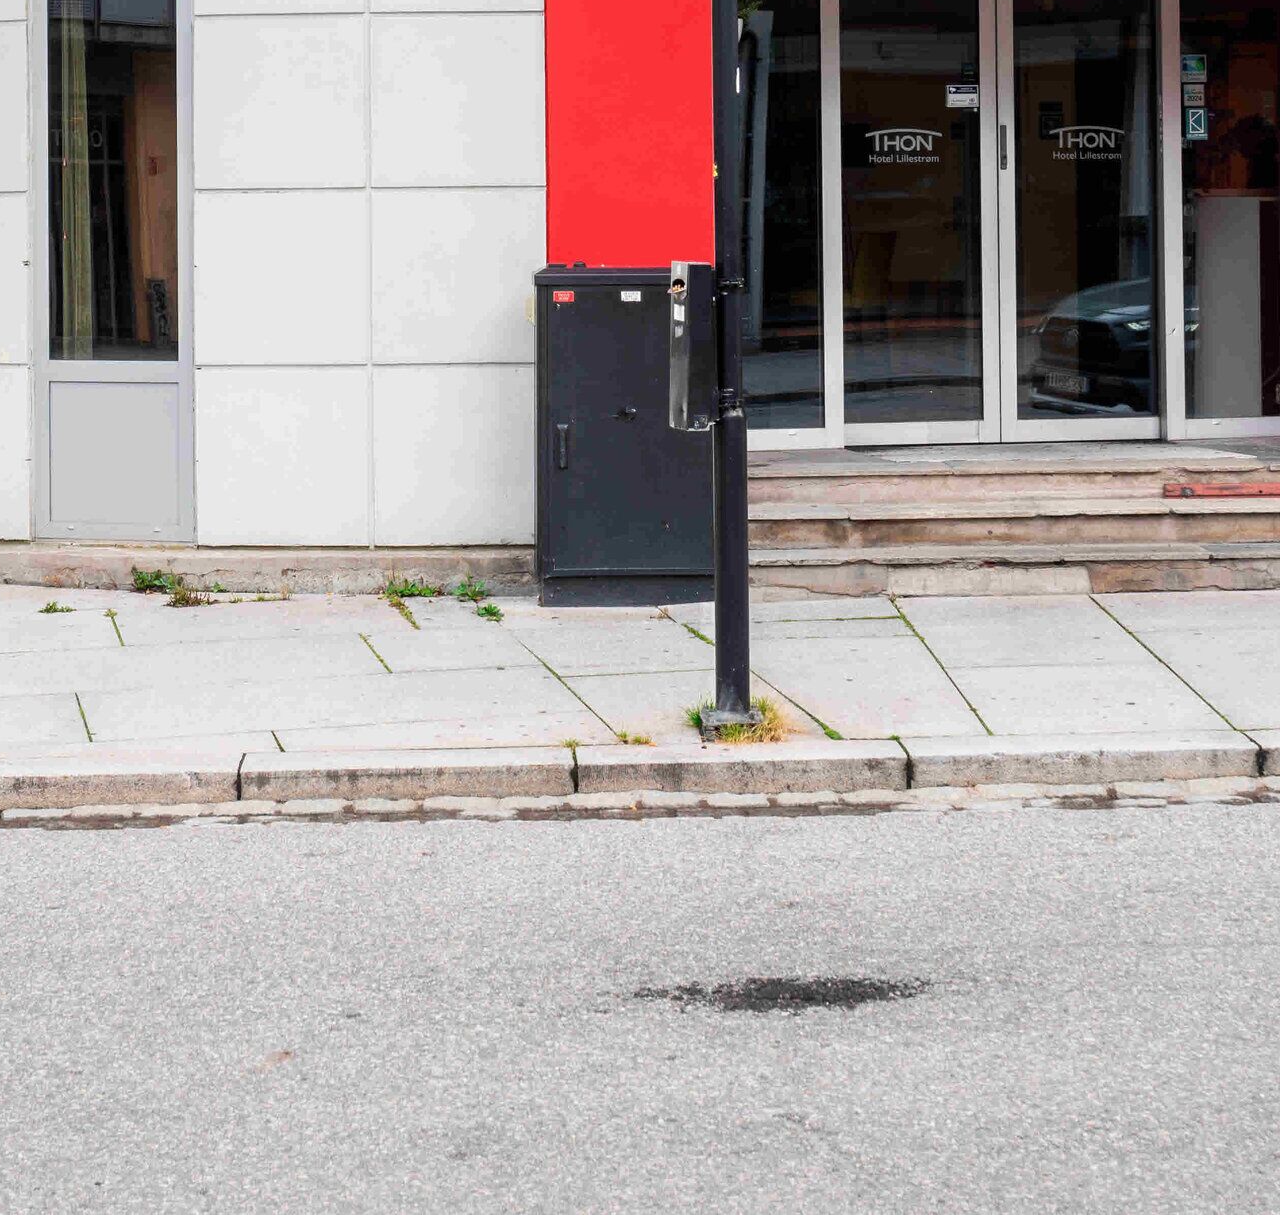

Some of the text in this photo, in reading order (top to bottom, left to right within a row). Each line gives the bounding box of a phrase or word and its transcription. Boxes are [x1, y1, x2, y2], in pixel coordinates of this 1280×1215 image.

[867, 129, 941, 151] THON
[1050, 126, 1124, 148] THON
[869, 154, 940, 163] Hotel Lillestrøm
[1052, 150, 1077, 160] Hotel
